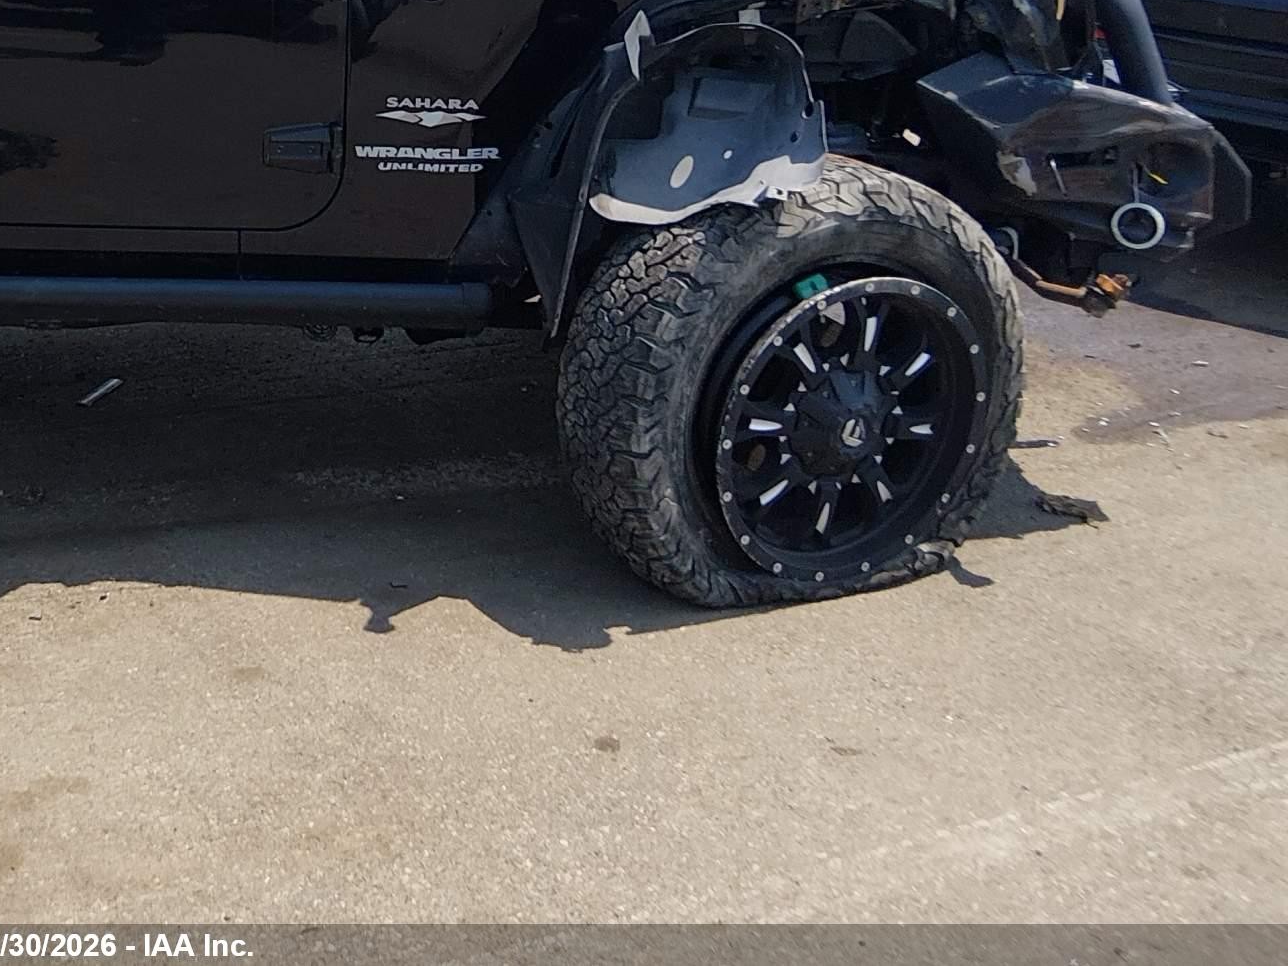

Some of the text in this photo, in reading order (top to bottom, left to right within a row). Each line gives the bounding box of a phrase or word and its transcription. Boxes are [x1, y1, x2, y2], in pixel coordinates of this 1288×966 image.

[386, 97, 479, 110] SAHARA
[354, 145, 501, 160] WRANGLER
[377, 162, 484, 173] UNLIMITED
